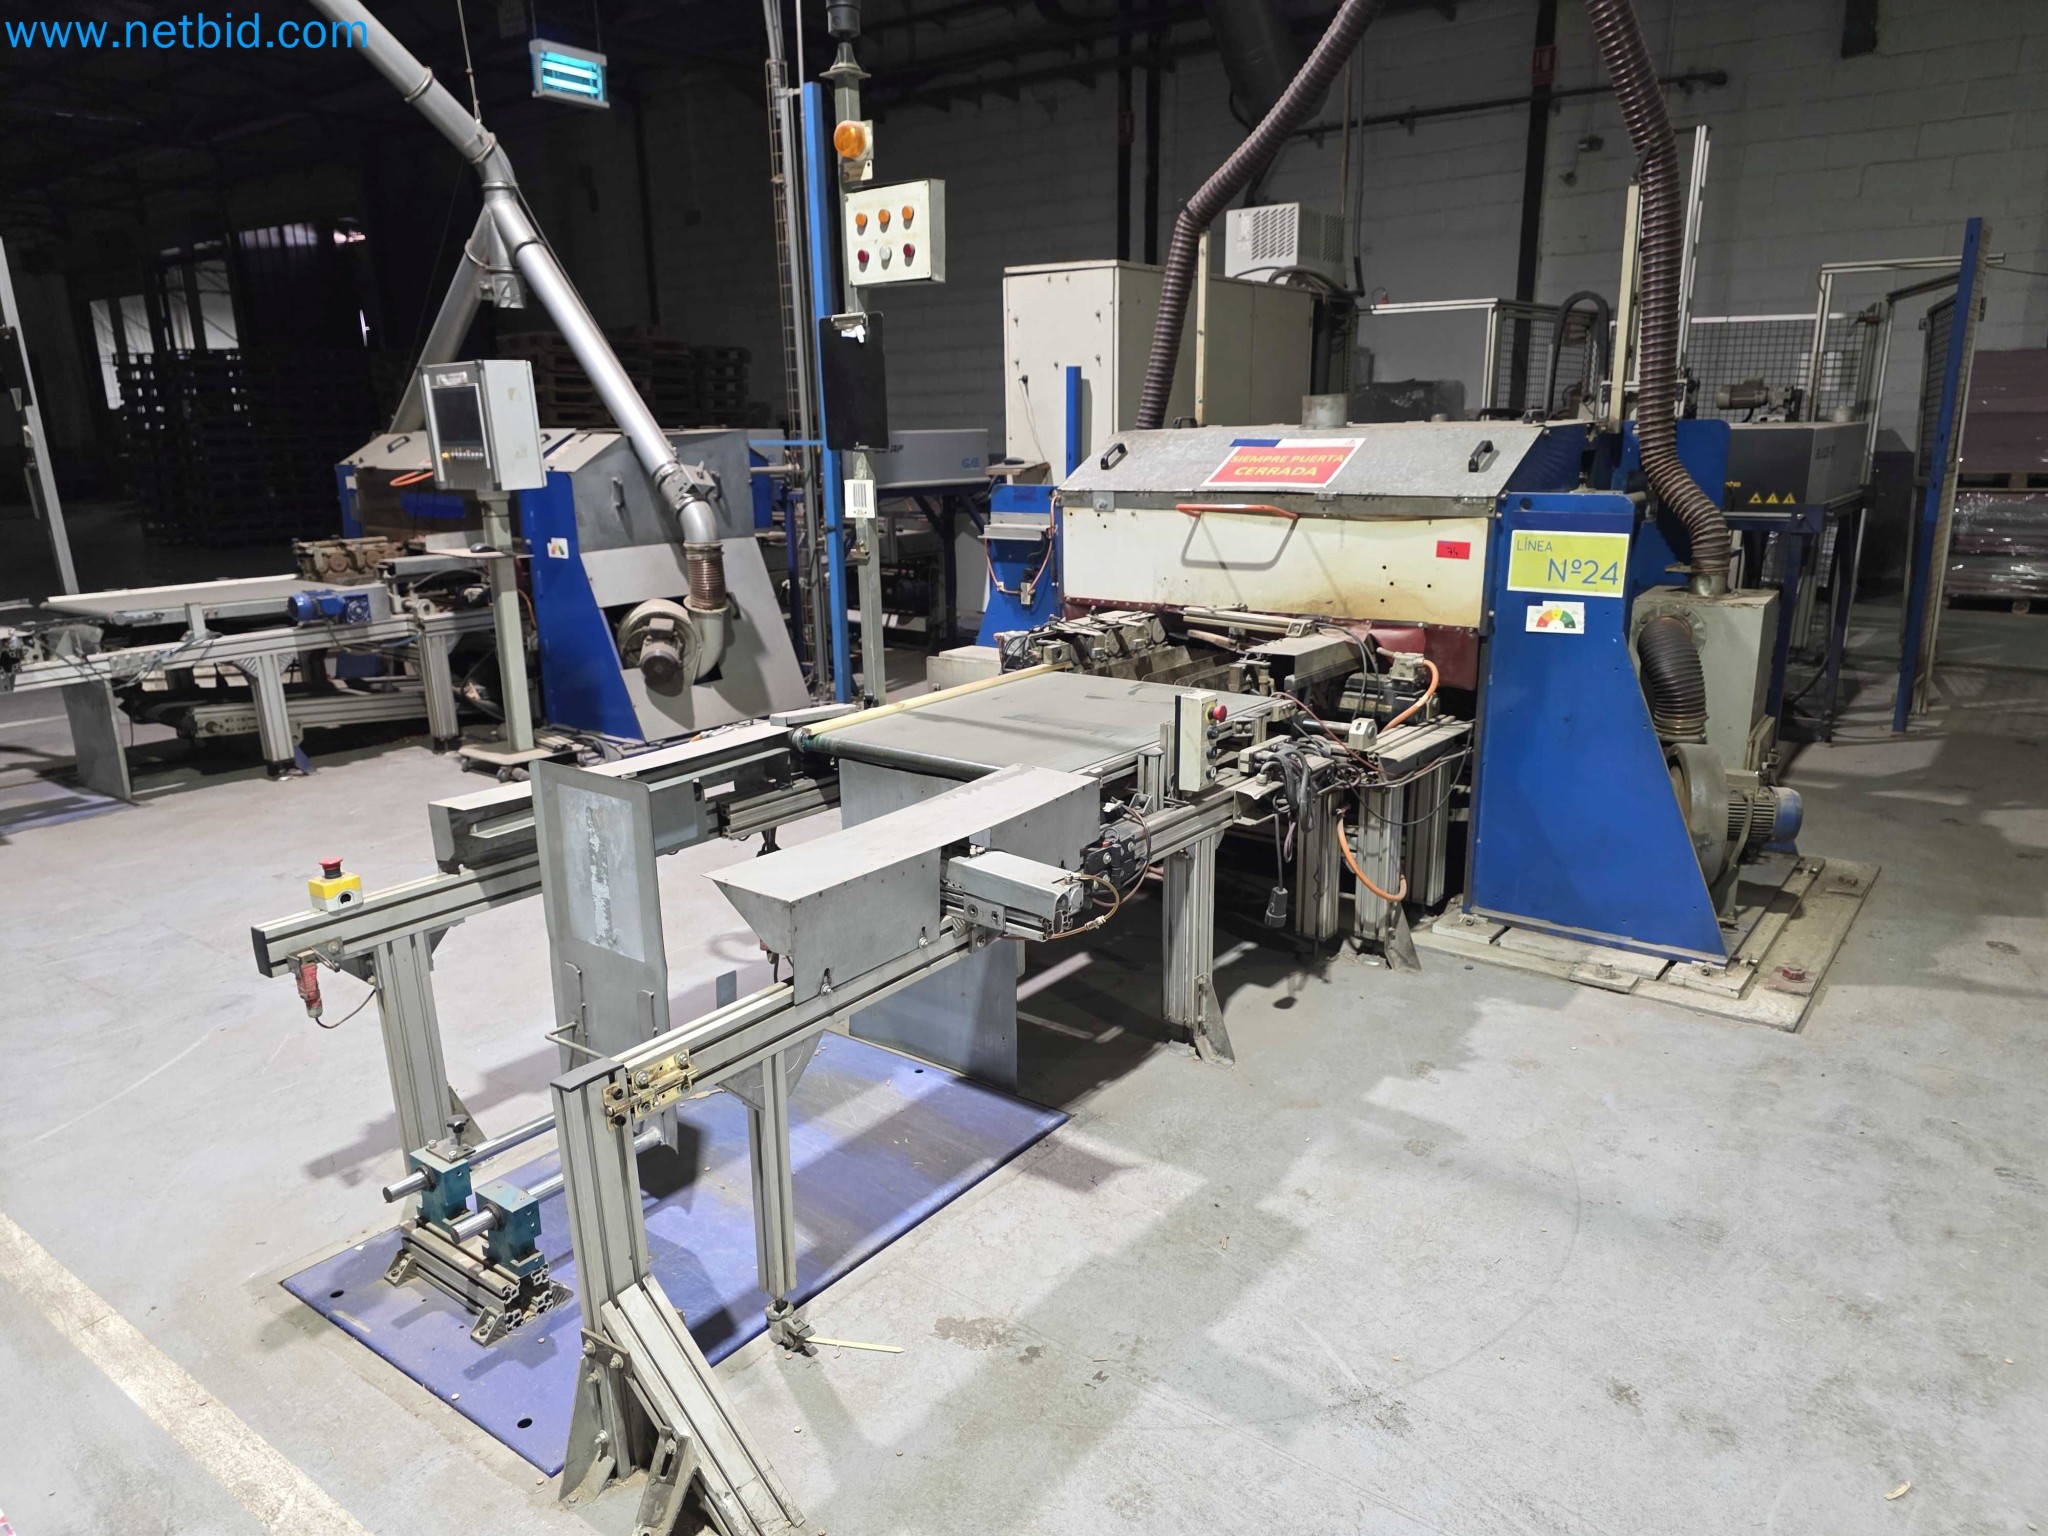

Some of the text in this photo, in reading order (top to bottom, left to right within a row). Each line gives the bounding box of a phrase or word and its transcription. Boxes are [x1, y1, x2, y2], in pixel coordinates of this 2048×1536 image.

[1231, 454, 1344, 463] SIEMPRE PUERTA
[1234, 466, 1318, 476] CERRADA
[1516, 537, 1553, 552] LÍNEA
[1547, 558, 1618, 585] Nº24
